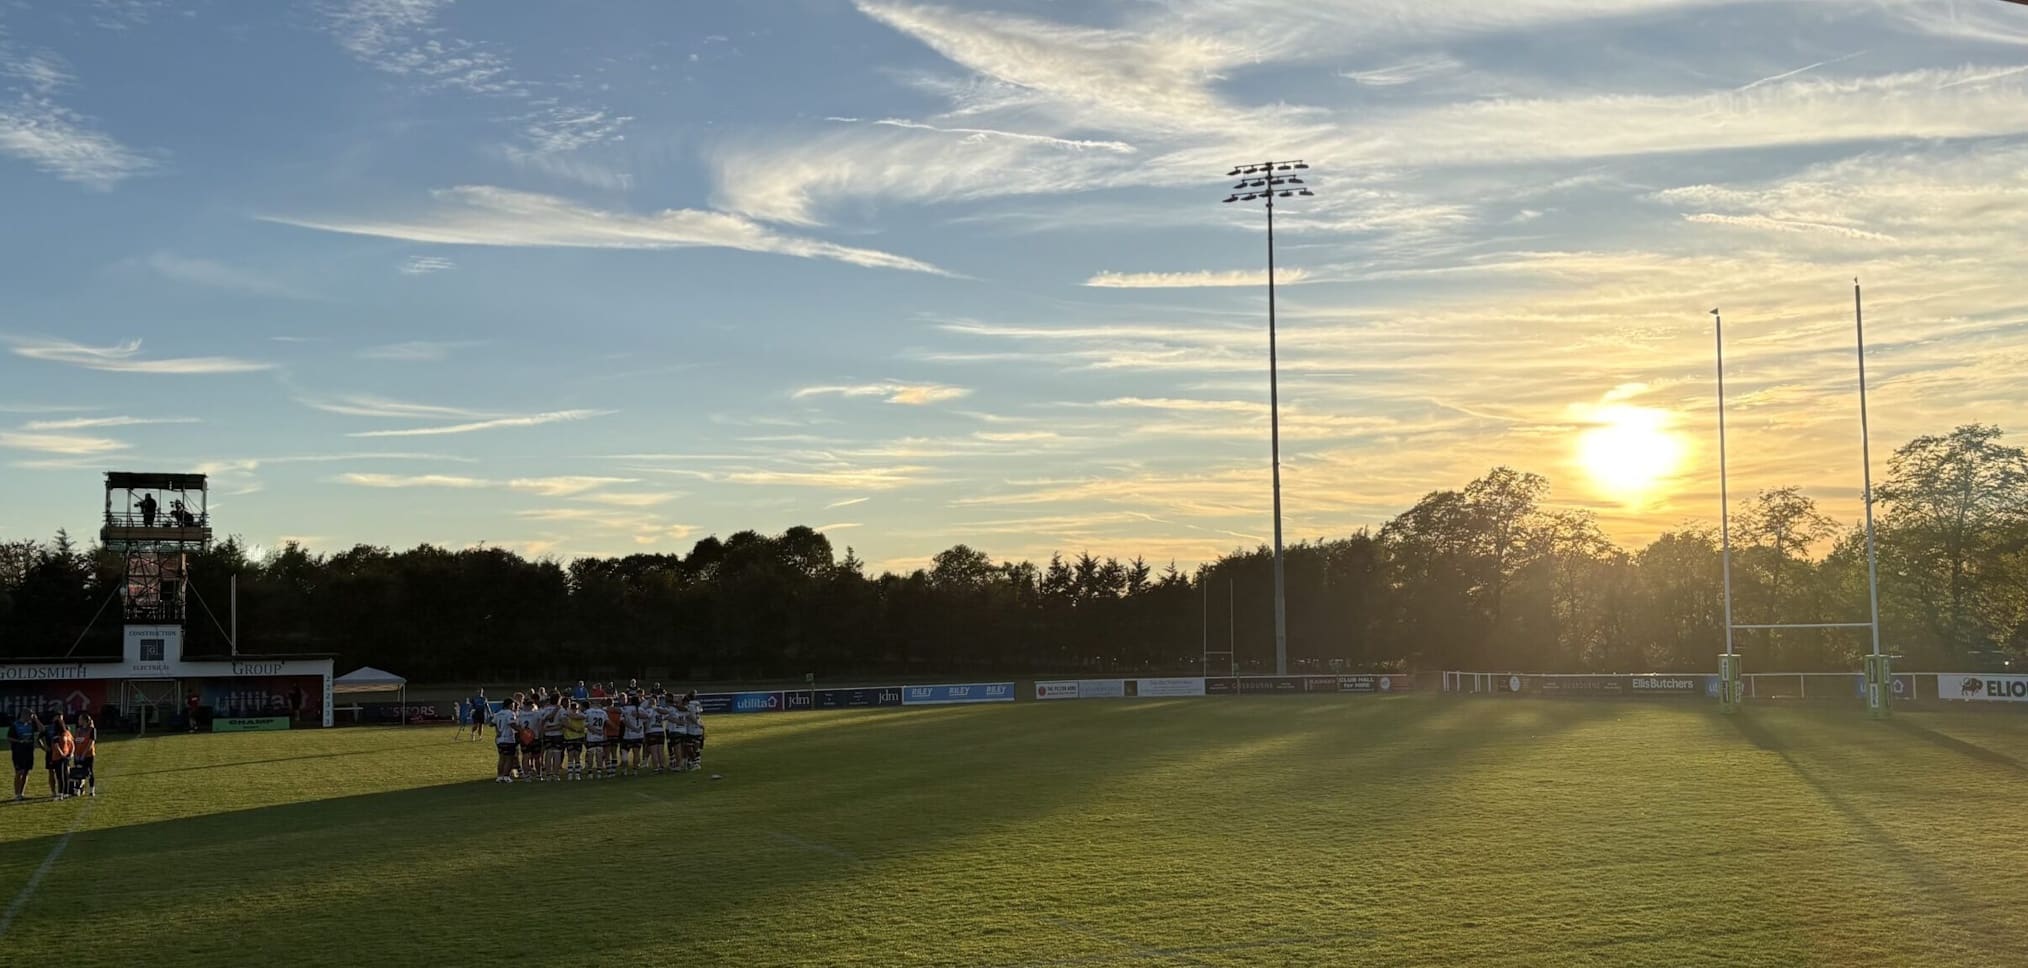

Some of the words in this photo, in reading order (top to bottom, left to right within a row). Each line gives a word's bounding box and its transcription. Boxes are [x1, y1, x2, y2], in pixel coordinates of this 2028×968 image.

[232, 661, 282, 675] GROUP
[1632, 678, 1650, 689] Ellis
[1650, 678, 1694, 689] Butchers
[1986, 680, 2028, 697] ELIO
[788, 692, 810, 708] jdm
[879, 689, 899, 704] jdm
